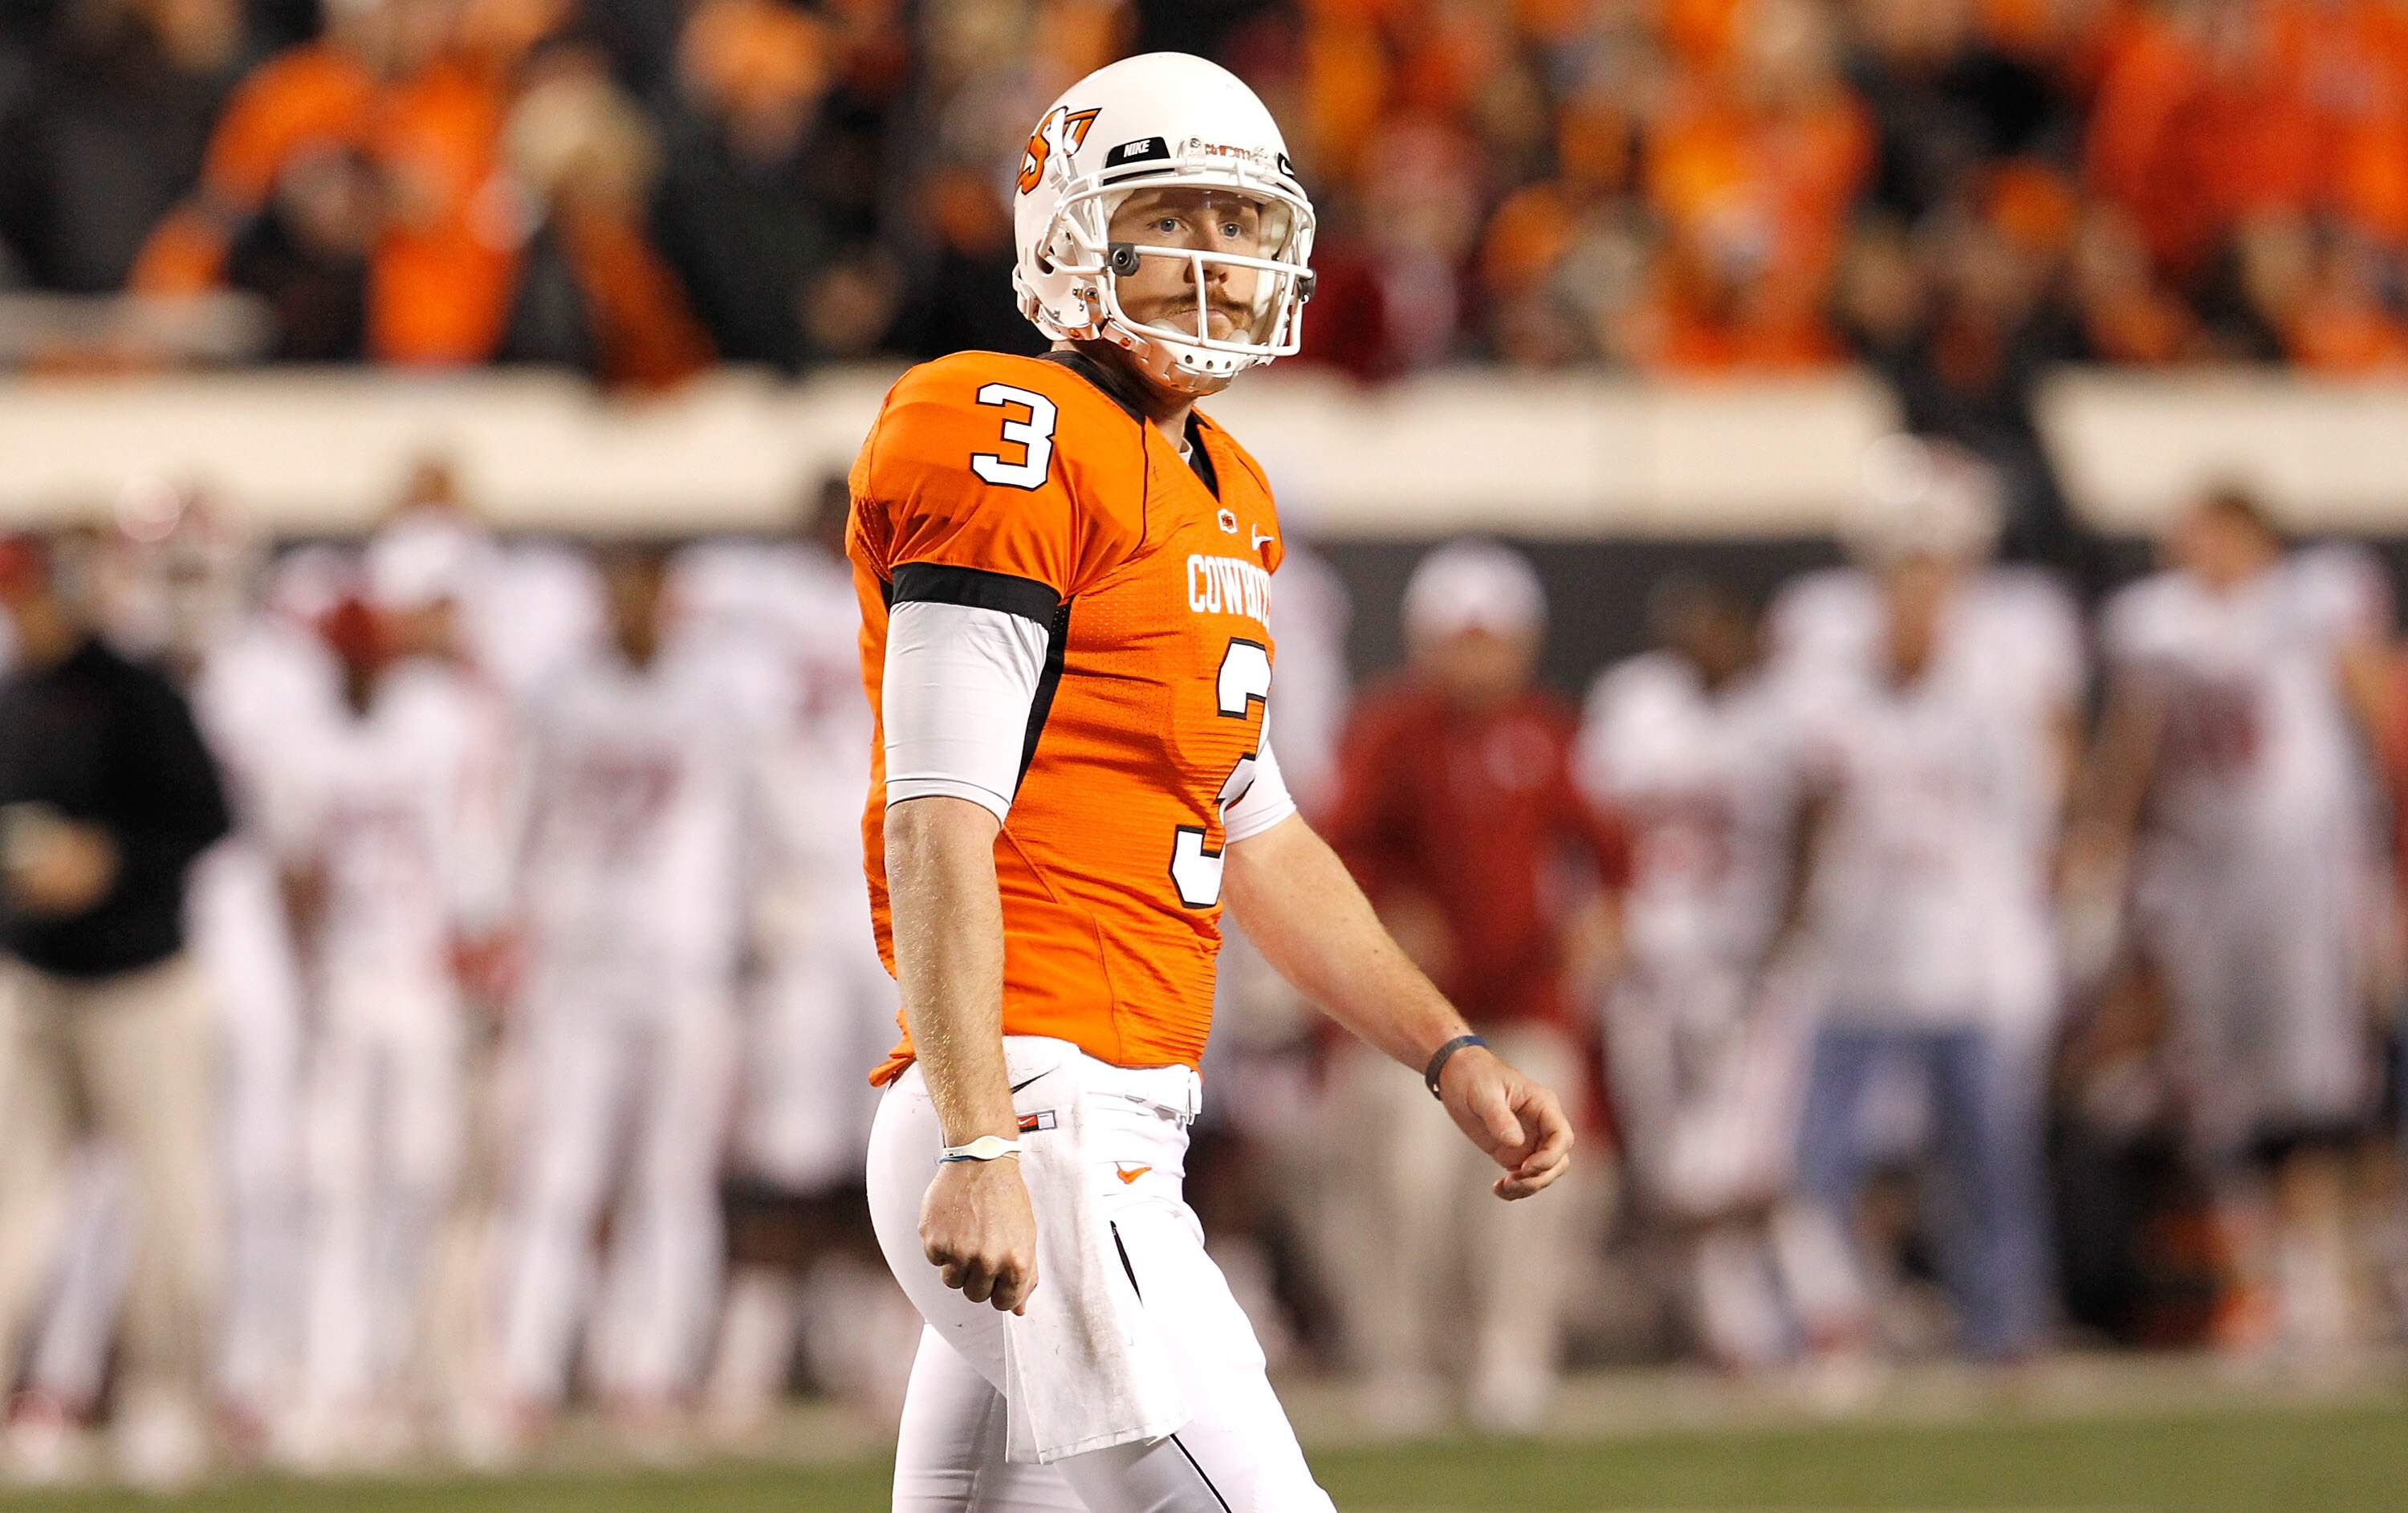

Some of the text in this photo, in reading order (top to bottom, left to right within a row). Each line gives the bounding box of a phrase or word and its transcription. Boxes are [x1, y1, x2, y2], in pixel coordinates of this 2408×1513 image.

[1123, 140, 1150, 158] NIKE
[970, 382, 1058, 492] 3
[1186, 554, 1271, 633] COWBOY
[1168, 636, 1272, 909] 3
